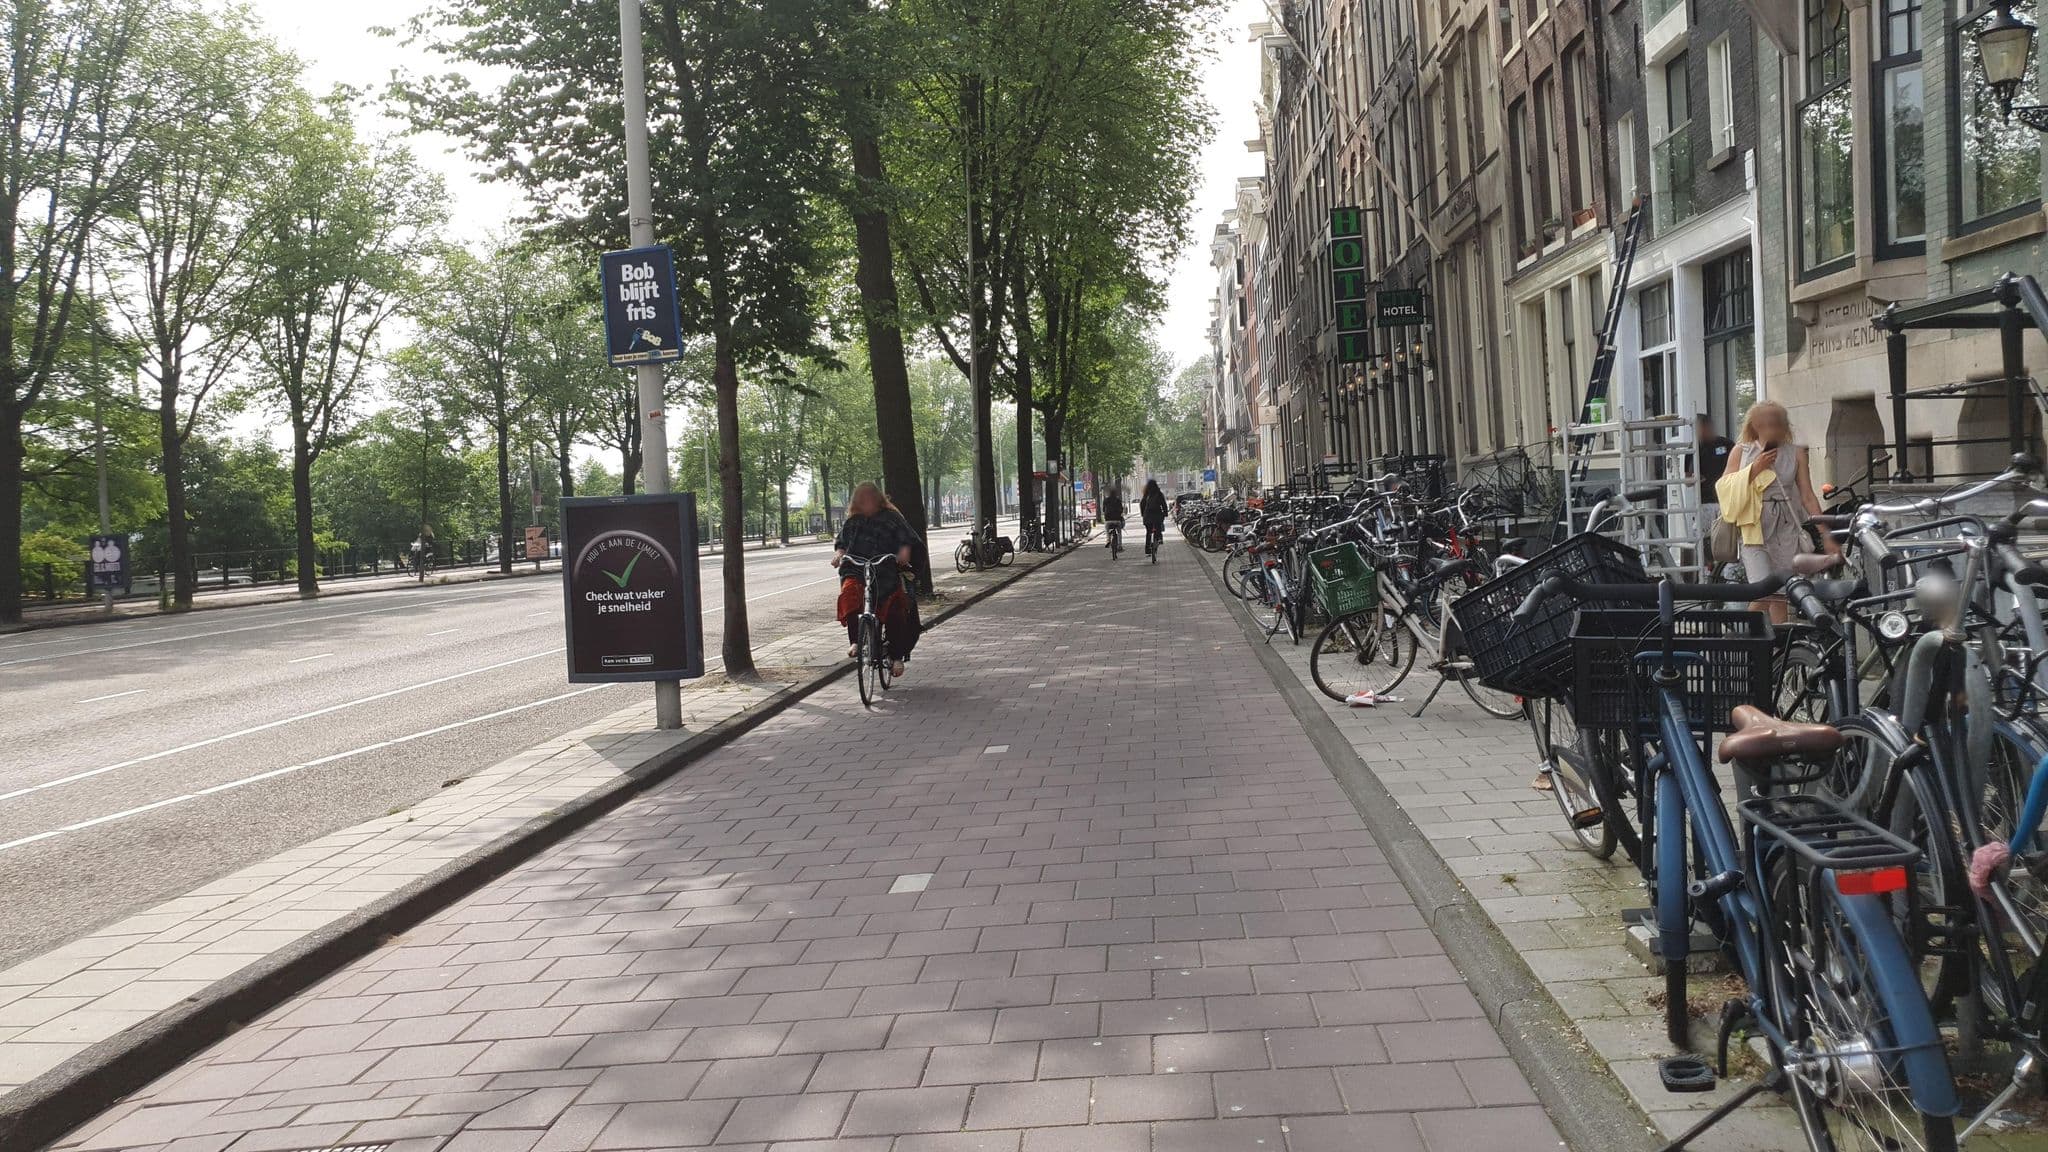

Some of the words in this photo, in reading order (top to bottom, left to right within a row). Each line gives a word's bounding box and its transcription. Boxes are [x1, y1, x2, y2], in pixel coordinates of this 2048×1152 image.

[621, 261, 655, 282] Bob
[619, 281, 660, 303] blijft
[1334, 210, 1363, 361] HOTEL
[626, 302, 657, 321] fris
[1383, 305, 1417, 317] HOTEL
[1845, 325, 1889, 348] HENDR
[586, 548, 600, 563] HOU
[599, 542, 607, 552] JE
[608, 538, 623, 548] AAN
[625, 538, 636, 548] DE
[637, 541, 660, 560] LIMIET
[585, 590, 613, 601] Check
[614, 591, 635, 601] wat
[635, 589, 665, 600] vaker
[597, 602, 607, 615] je
[608, 600, 651, 613] snelheid
